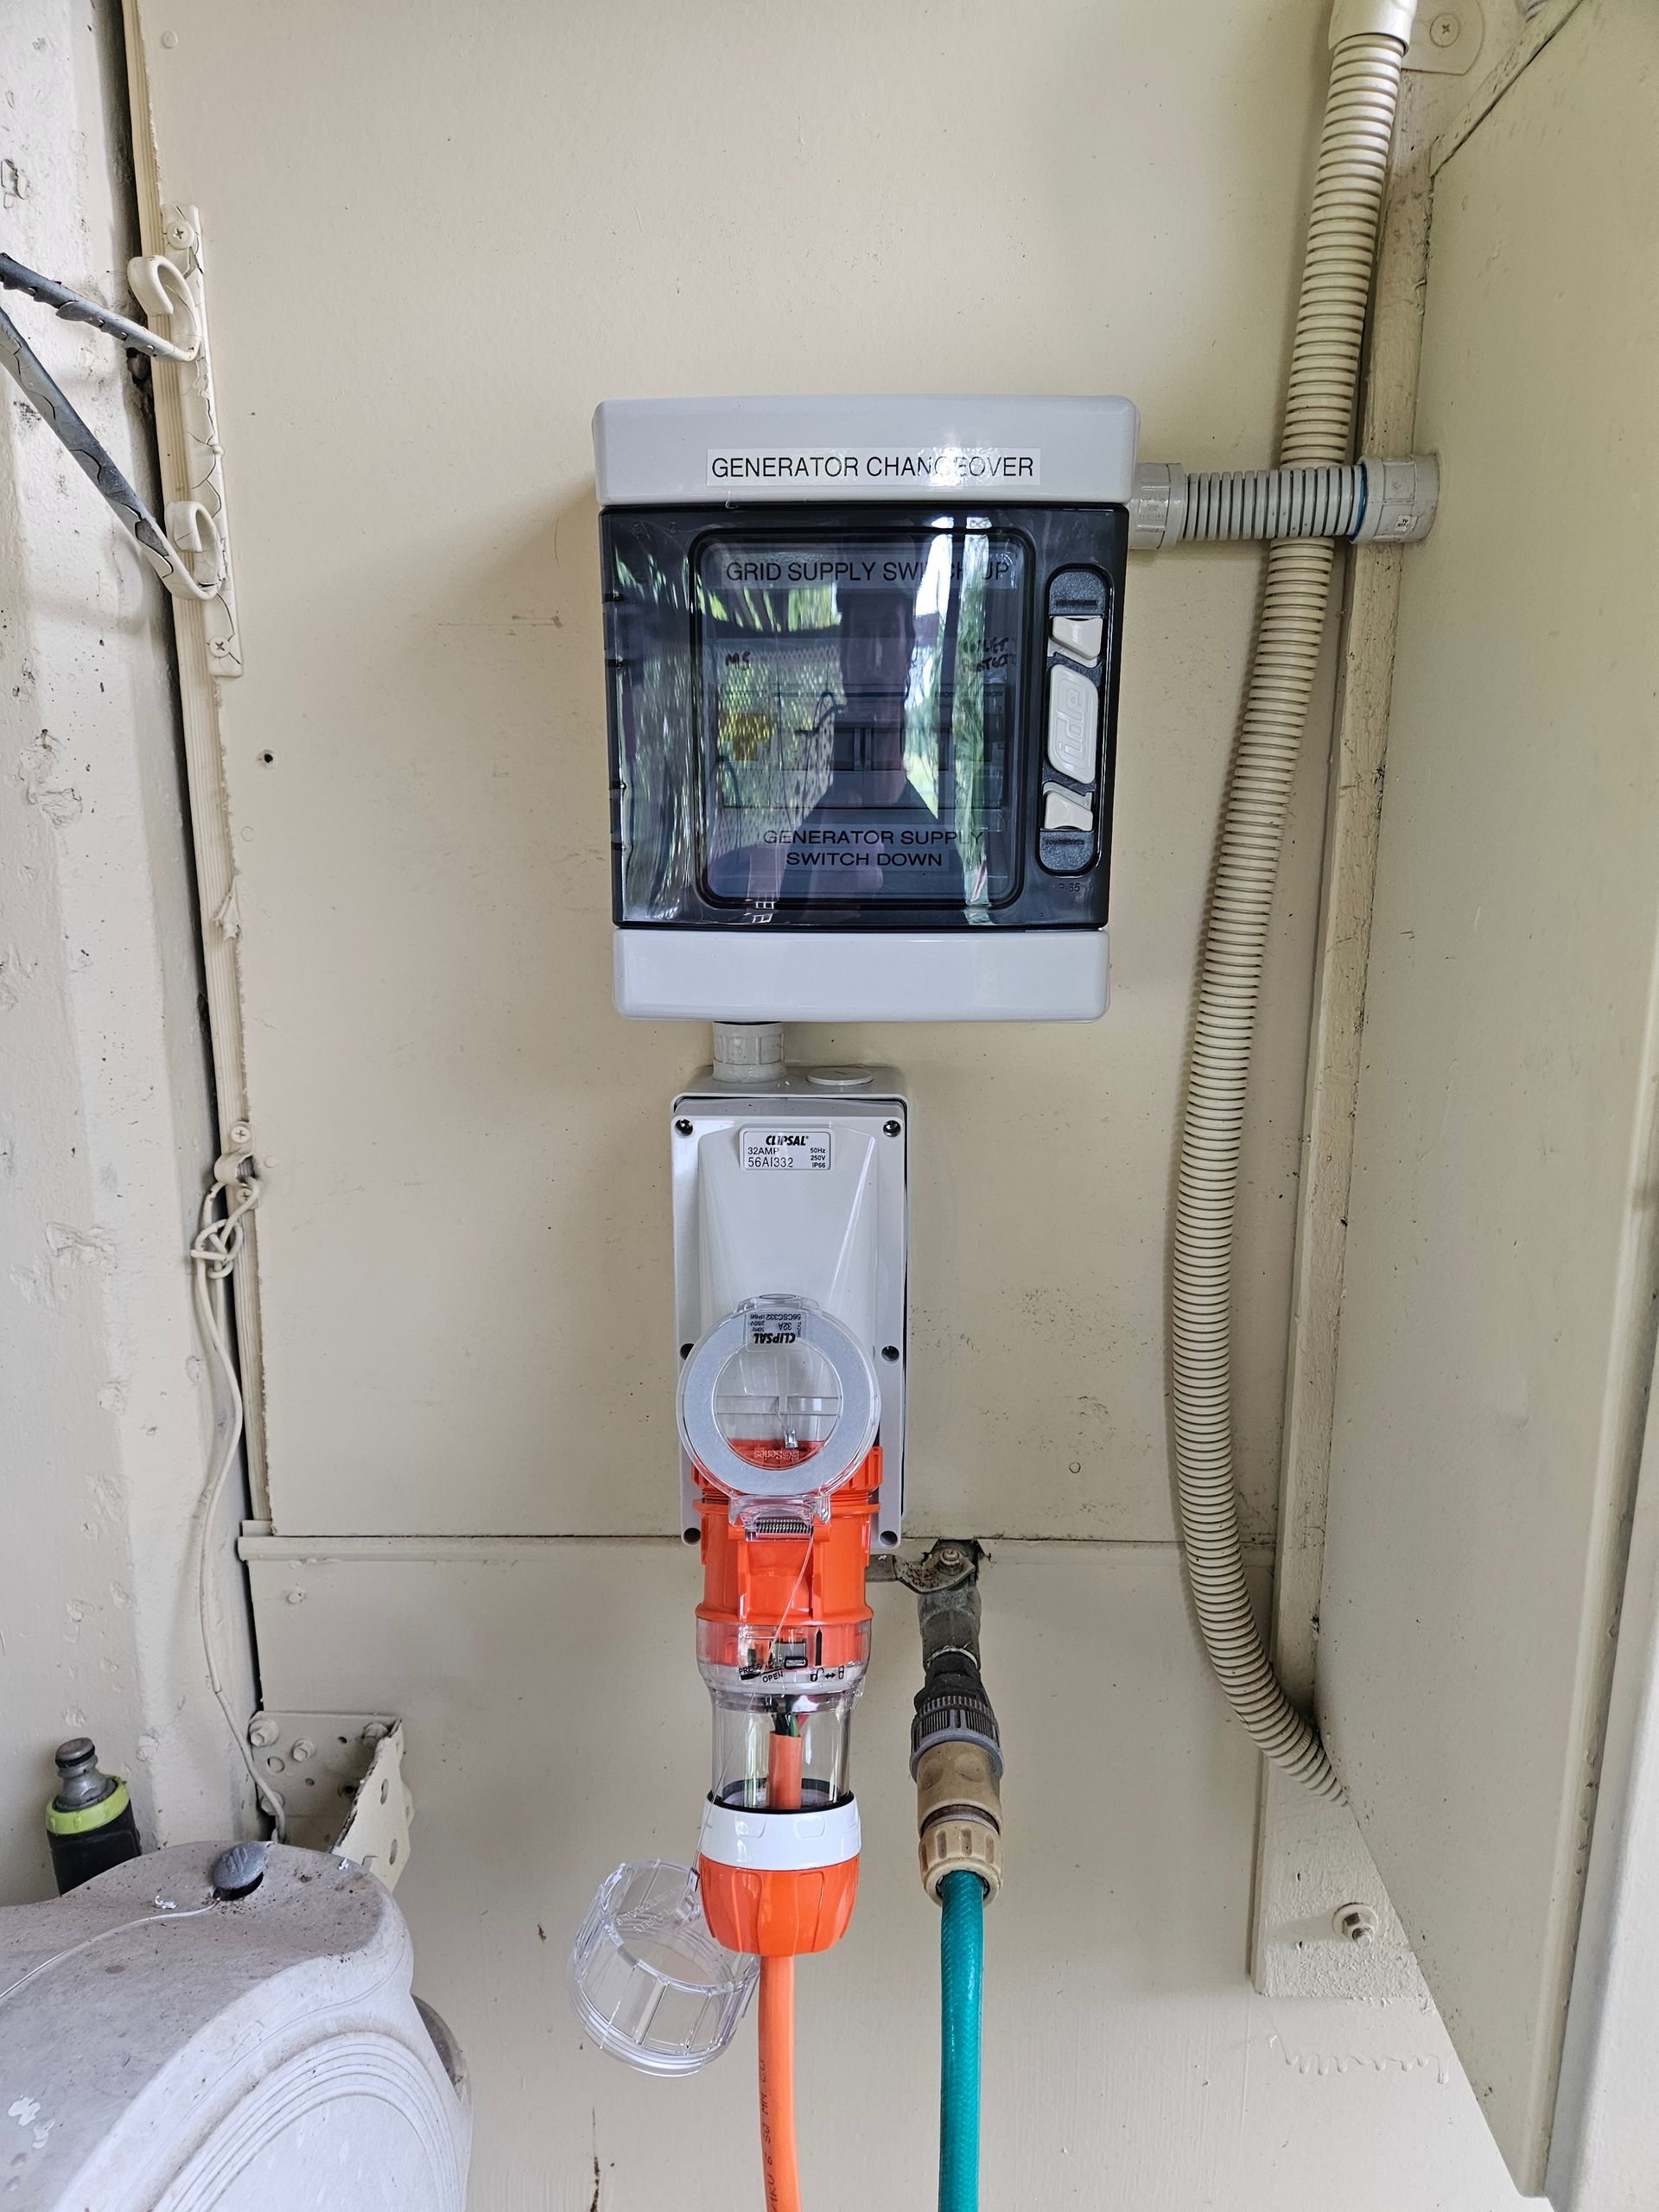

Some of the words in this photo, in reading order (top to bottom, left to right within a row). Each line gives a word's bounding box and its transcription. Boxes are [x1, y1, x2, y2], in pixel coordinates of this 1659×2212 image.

[711, 456, 858, 478] GENERATOR
[726, 562, 782, 582] GRID
[787, 562, 874, 582] SUPPLY
[882, 562, 970, 582] SWIH
[763, 830, 894, 845] GENERATOR
[900, 830, 983, 845] SUPPLY
[786, 852, 868, 867] SWITCH
[877, 852, 942, 868] DOWN
[766, 1135, 806, 1146] CLIPSAL
[747, 1147, 779, 1155] 32AMP
[778, 1322, 792, 1332] 32A
[753, 1332, 796, 1344] CLIPSAL
[762, 1670, 784, 1683] OPEN
